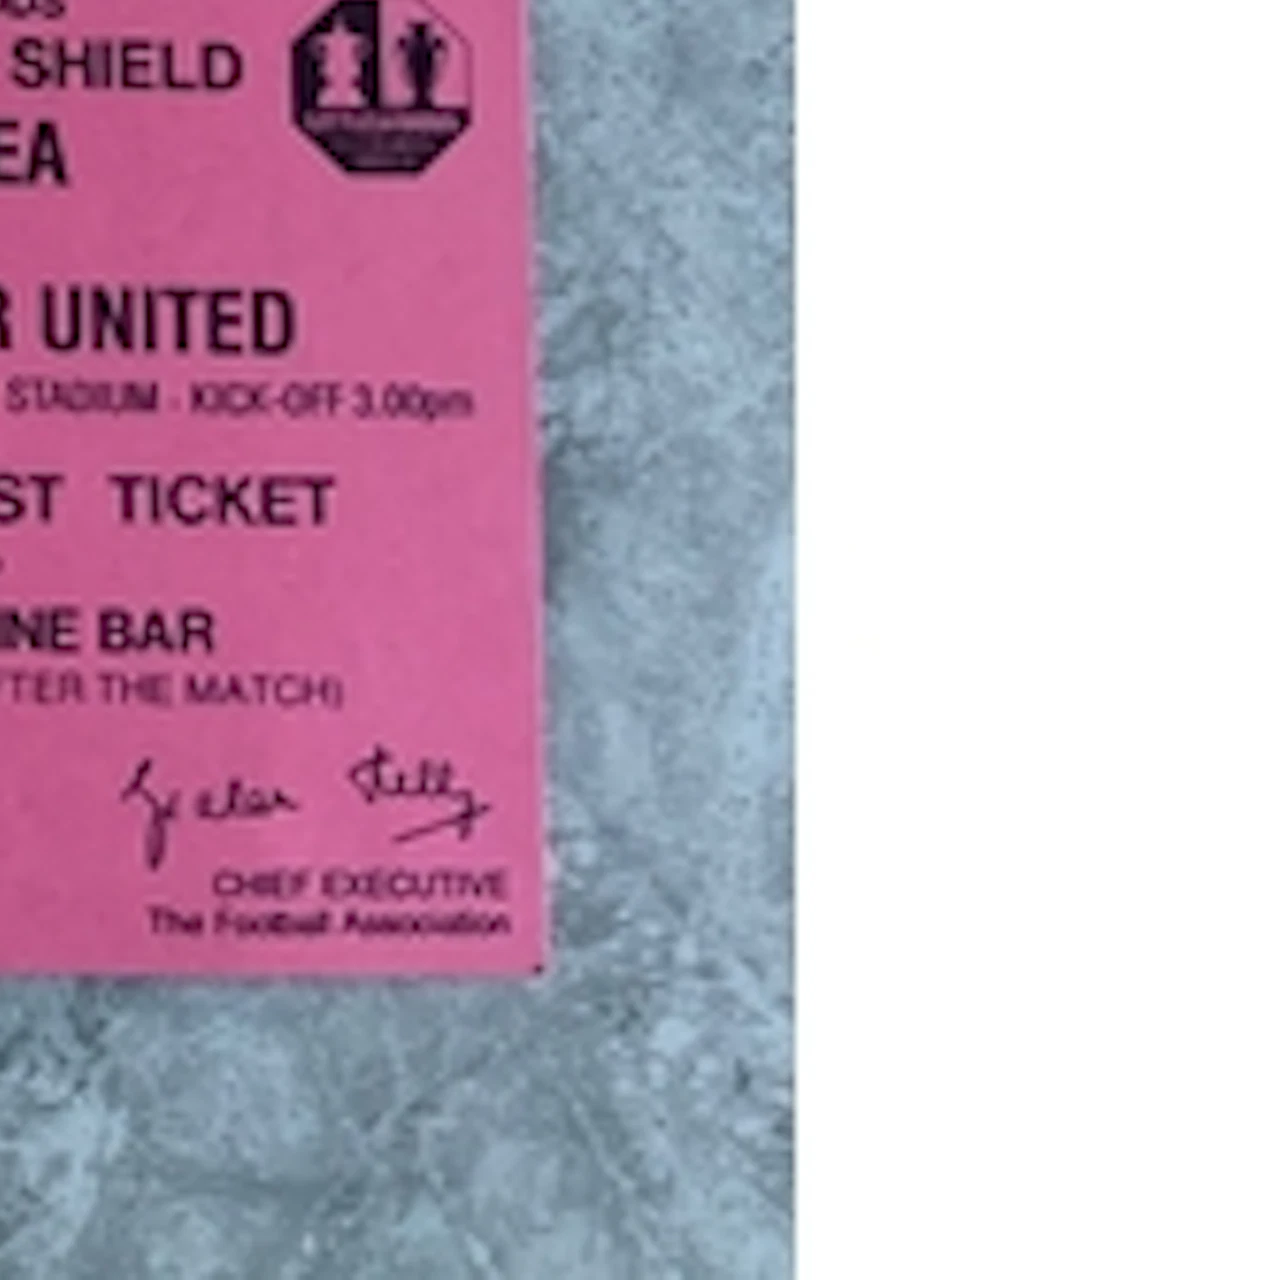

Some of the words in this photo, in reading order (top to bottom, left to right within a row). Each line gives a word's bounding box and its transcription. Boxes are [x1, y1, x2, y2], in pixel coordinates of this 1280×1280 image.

[10, 36, 244, 92] SHIELD
[41, 285, 295, 356] UNITED
[6, 375, 160, 415] STADIUM
[189, 381, 343, 418] KICK-OFF
[353, 381, 475, 423] 3.00pm
[108, 473, 334, 527] TICKET
[98, 608, 215, 654] BAR
[96, 671, 172, 707] THE
[184, 673, 343, 707] MATCH)
[211, 868, 307, 900] CHIEF
[320, 868, 505, 902] EXECUTIVE
[149, 906, 205, 937] The
[213, 908, 332, 938] Football
[341, 909, 512, 938] Association
